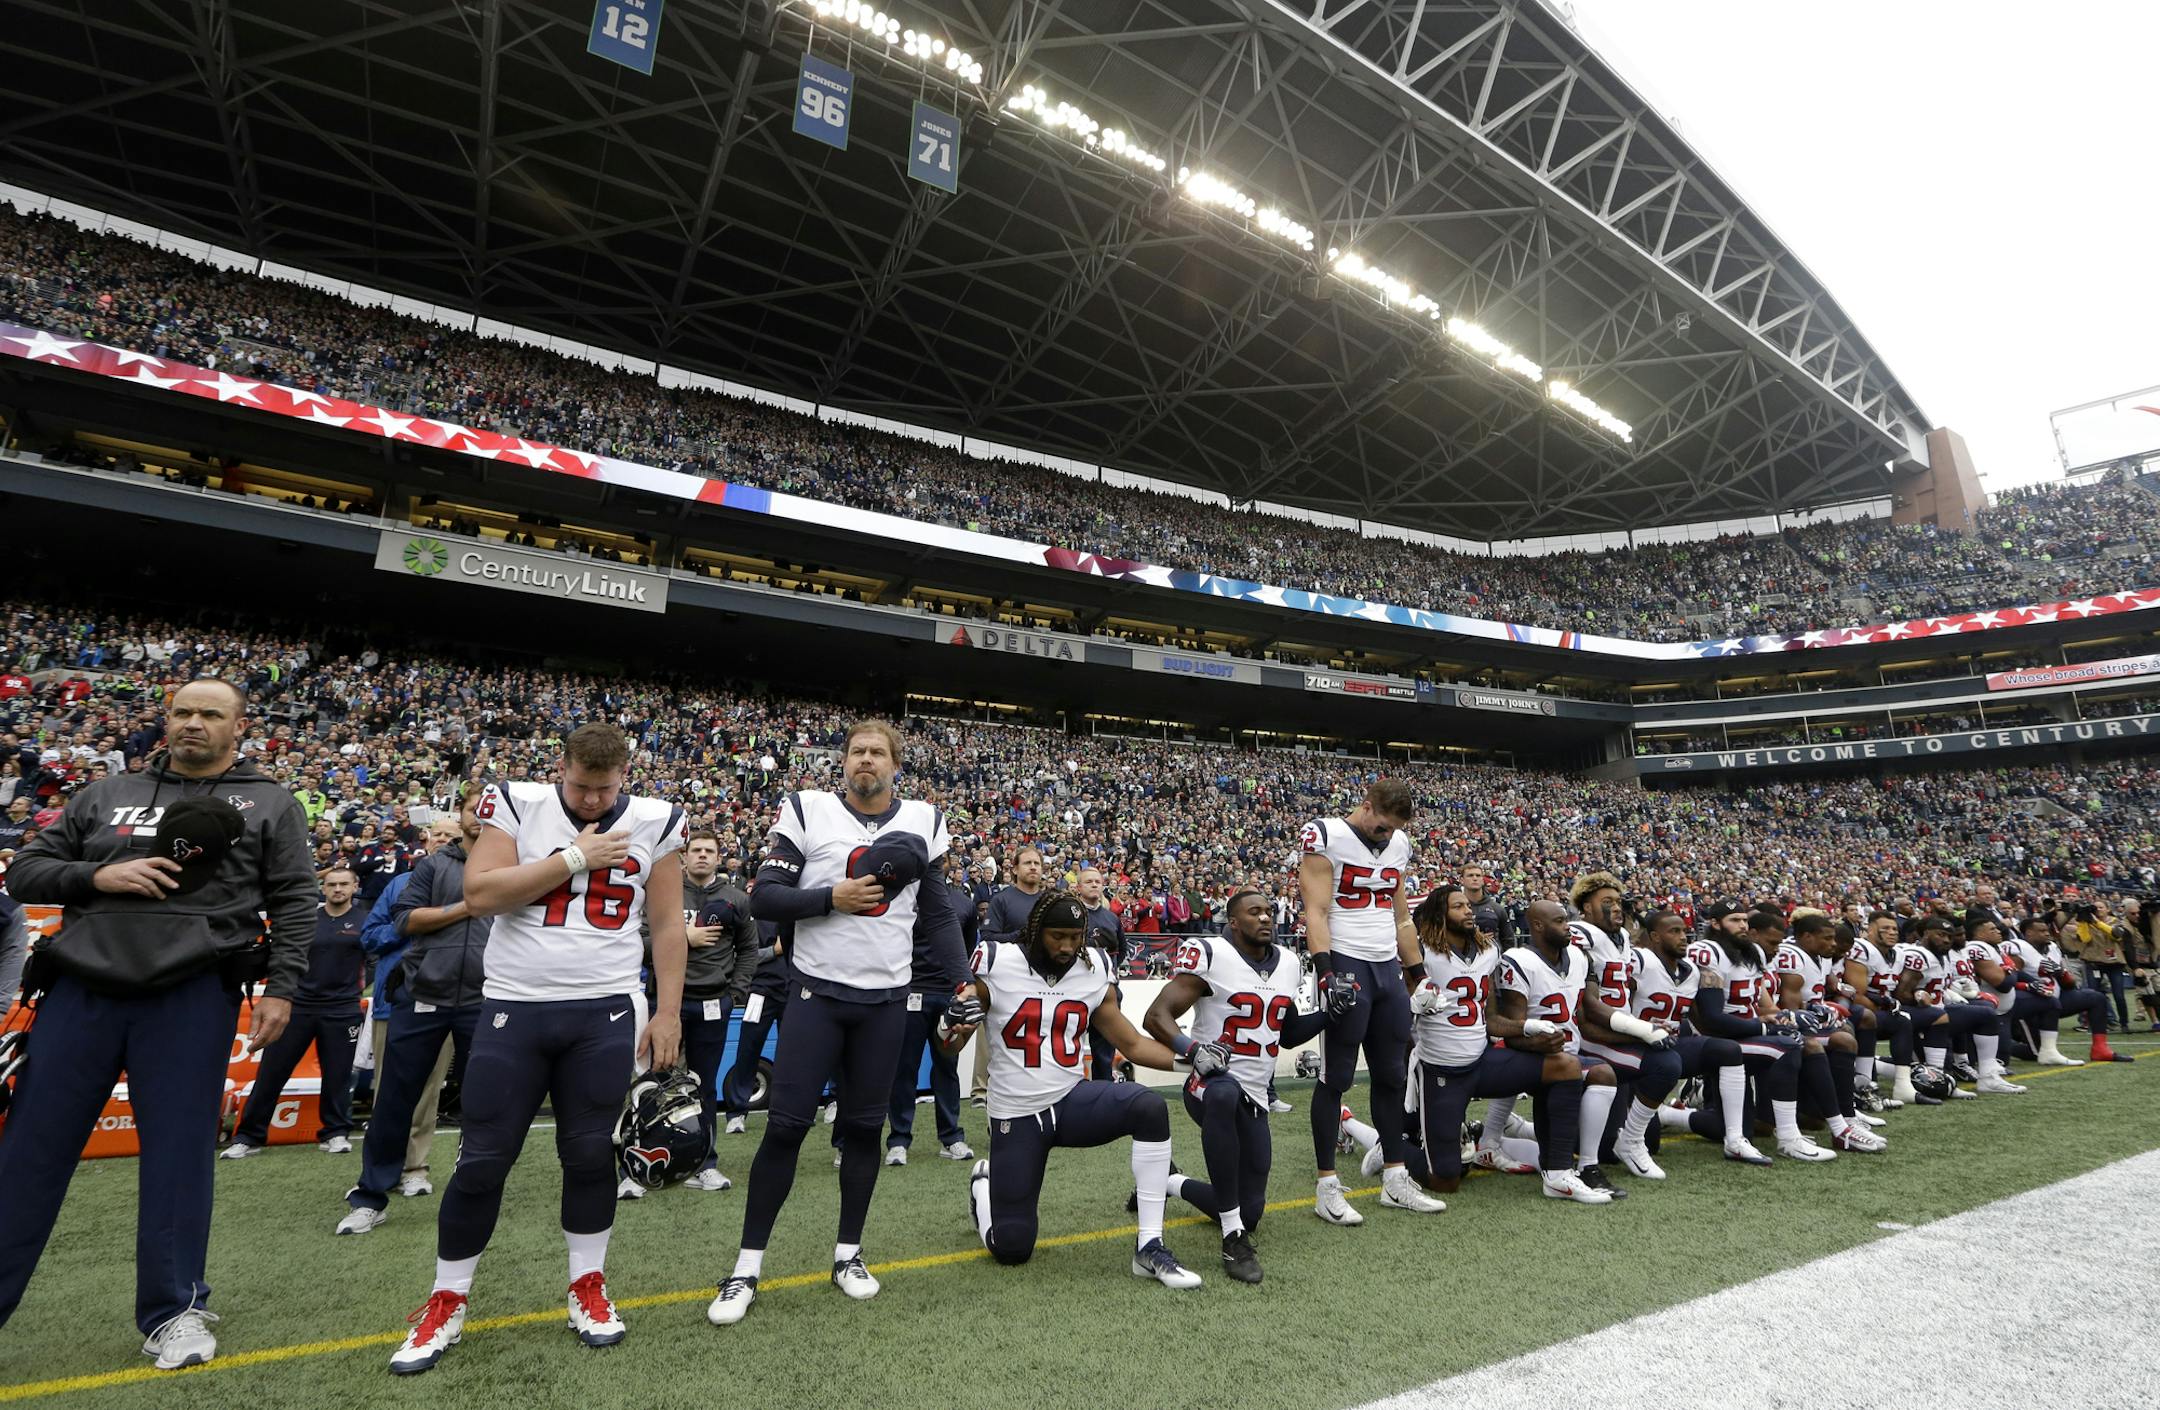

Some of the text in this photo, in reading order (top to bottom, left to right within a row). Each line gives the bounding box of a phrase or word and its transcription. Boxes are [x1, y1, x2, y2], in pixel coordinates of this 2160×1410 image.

[602, 6, 649, 49] 12
[803, 69, 849, 95] KENNEDY
[801, 86, 845, 128] 96
[921, 120, 952, 138] JONES
[918, 133, 951, 172] 71
[460, 552, 647, 603] CenturyLink
[982, 629, 1073, 660] DELTA
[1163, 656, 1236, 678] BUD LIGHT
[2004, 671, 2051, 685] Whose
[2054, 665, 2095, 681] broad
[2099, 660, 2148, 676] stripes
[1306, 676, 1330, 688] 710
[1344, 680, 1387, 696] ESPN
[1389, 688, 1415, 696] SEATTLE
[1418, 681, 1430, 692] 12
[1474, 695, 1538, 710] JIMMY JOHN'S
[1717, 718, 2151, 768] WELCOME TO CENTURY
[526, 847, 641, 931] 46
[1335, 863, 1400, 909] 52
[1174, 945, 1201, 971] 29
[1688, 949, 1711, 966] 50
[1778, 953, 1797, 970] 21
[1905, 955, 1924, 970] 58
[1001, 997, 1089, 1068] 40
[1223, 991, 1292, 1058] 29
[271, 1101, 300, 1129] G
